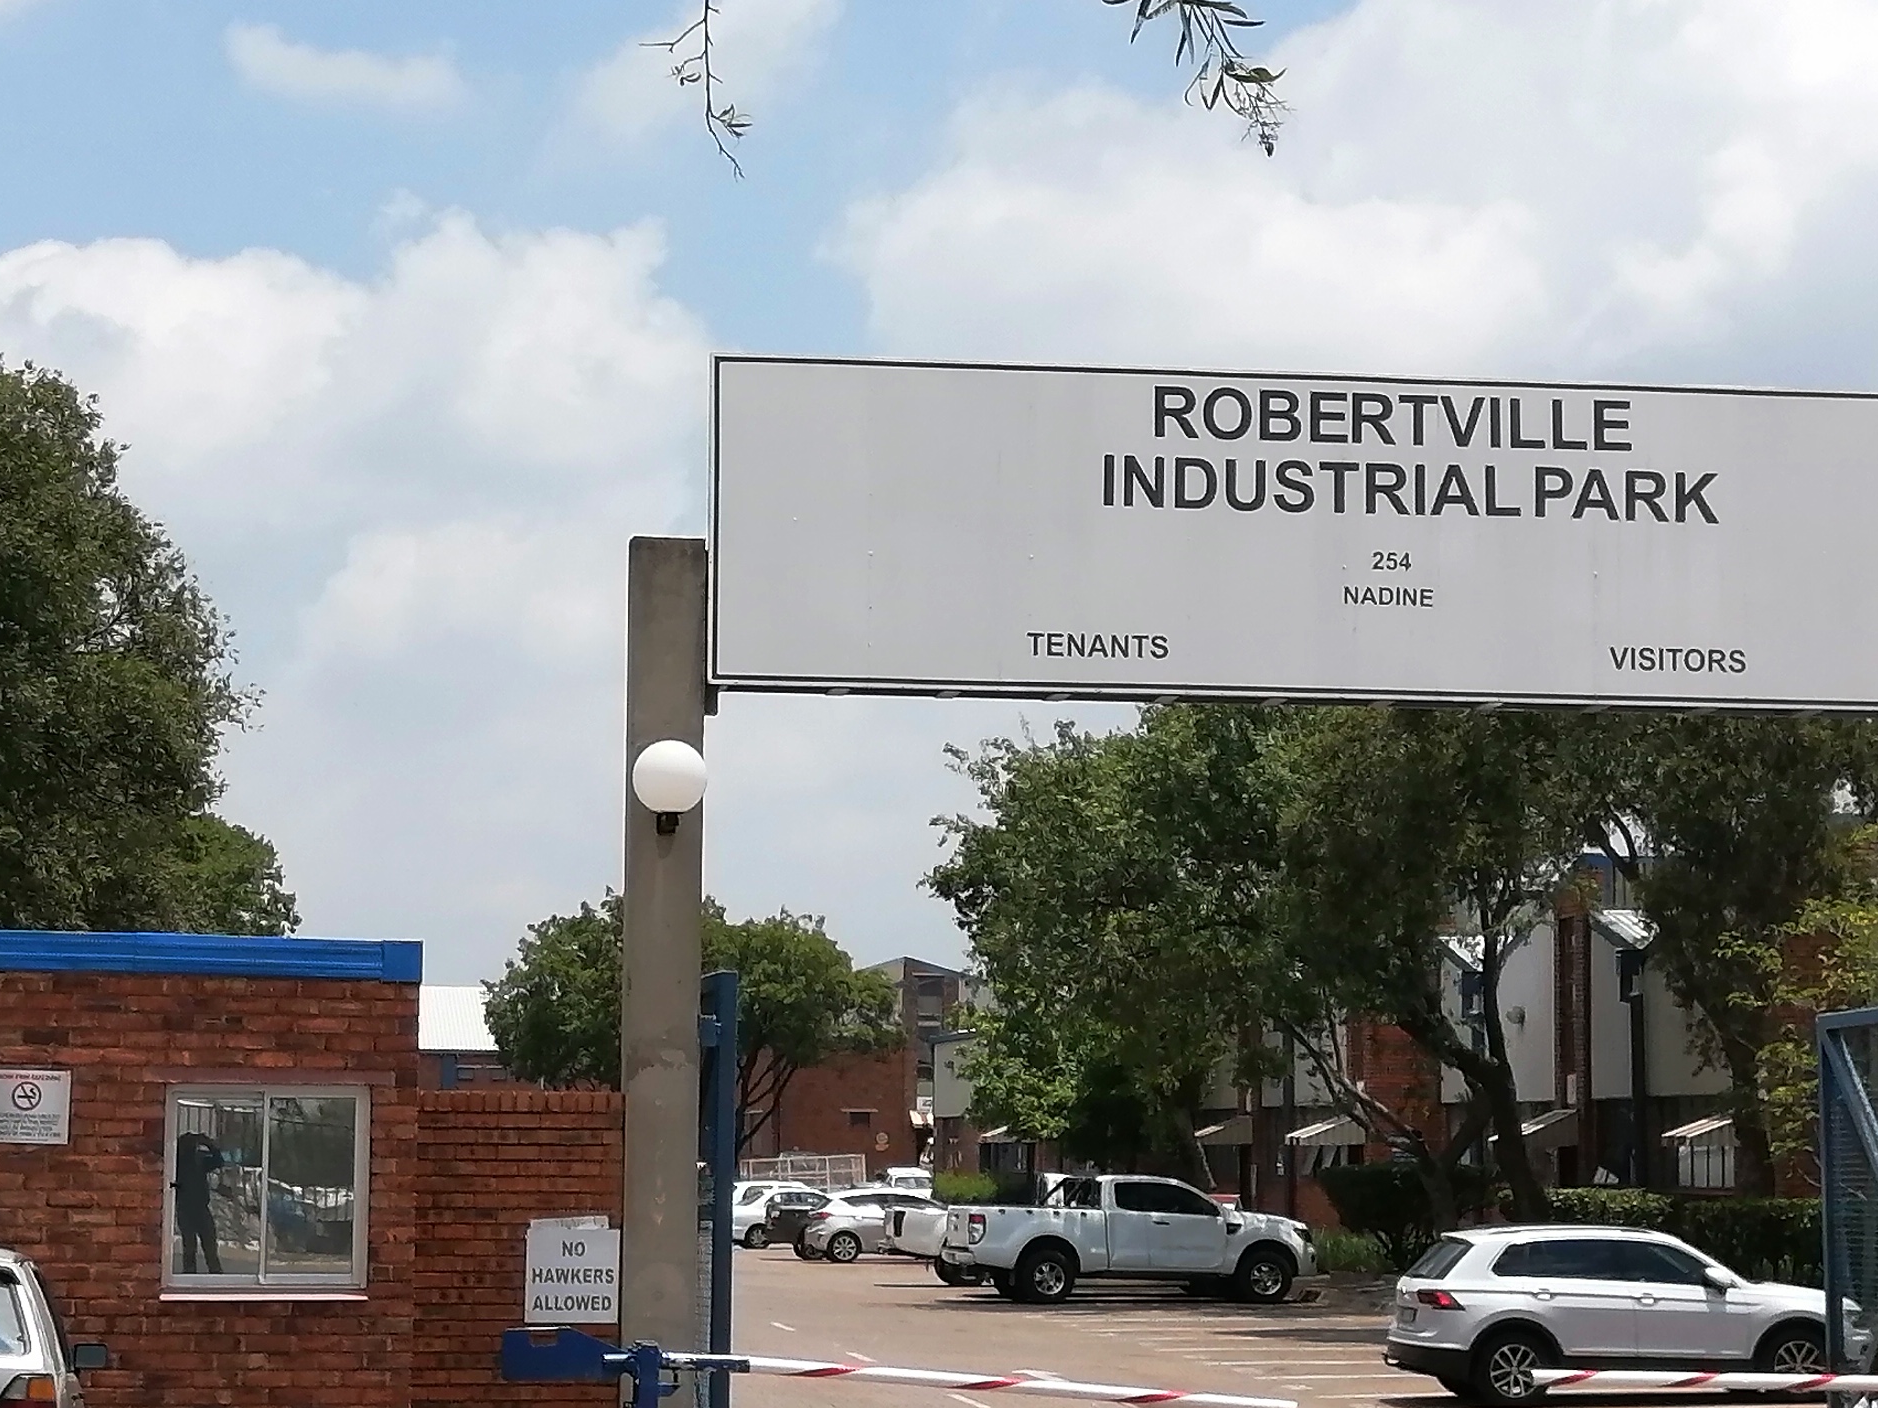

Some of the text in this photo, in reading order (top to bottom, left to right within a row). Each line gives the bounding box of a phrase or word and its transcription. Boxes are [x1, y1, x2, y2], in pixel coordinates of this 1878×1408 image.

[1151, 386, 1633, 453] ROBERTVILLE
[1103, 453, 1720, 526] INDUSTRIAL PARK
[1370, 551, 1412, 572] 254
[1342, 585, 1434, 609] NADINE
[1026, 632, 1747, 674] TENANTS VISITORS
[561, 1240, 586, 1257] NO
[531, 1267, 615, 1285] HAWKERS
[531, 1294, 612, 1312] ALLOWED
